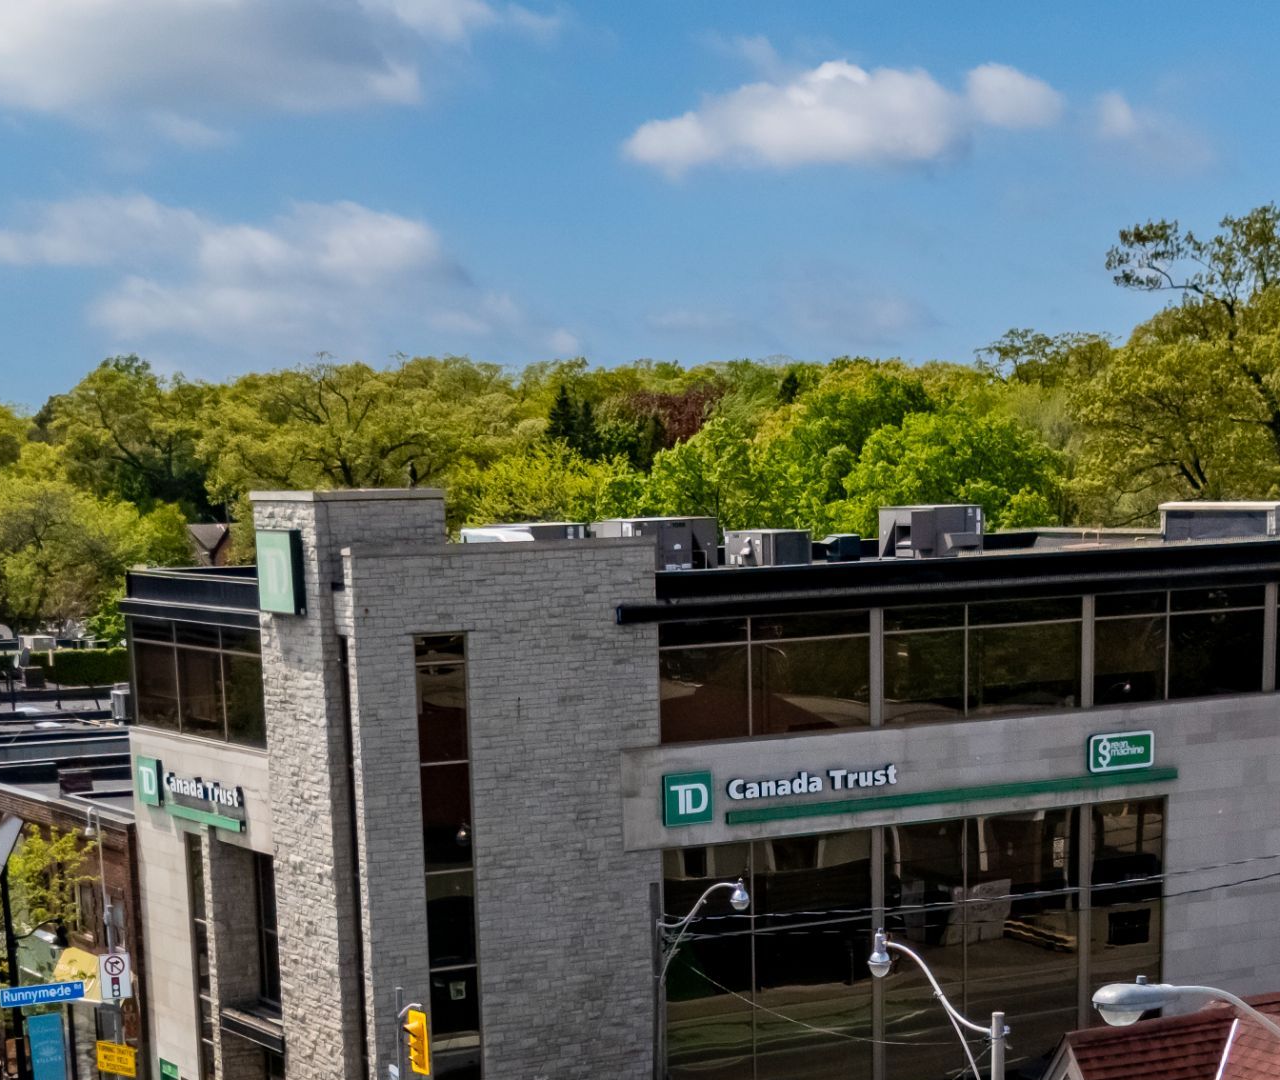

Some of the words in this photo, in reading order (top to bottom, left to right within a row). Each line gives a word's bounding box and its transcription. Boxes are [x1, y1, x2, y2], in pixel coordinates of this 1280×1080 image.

[139, 765, 157, 795] TD
[163, 772, 204, 800] Canada
[205, 782, 239, 808] Trust
[728, 771, 824, 800] Canada
[829, 764, 897, 790] Trust
[669, 783, 709, 815] TD
[2, 986, 72, 1003] Runnymede
